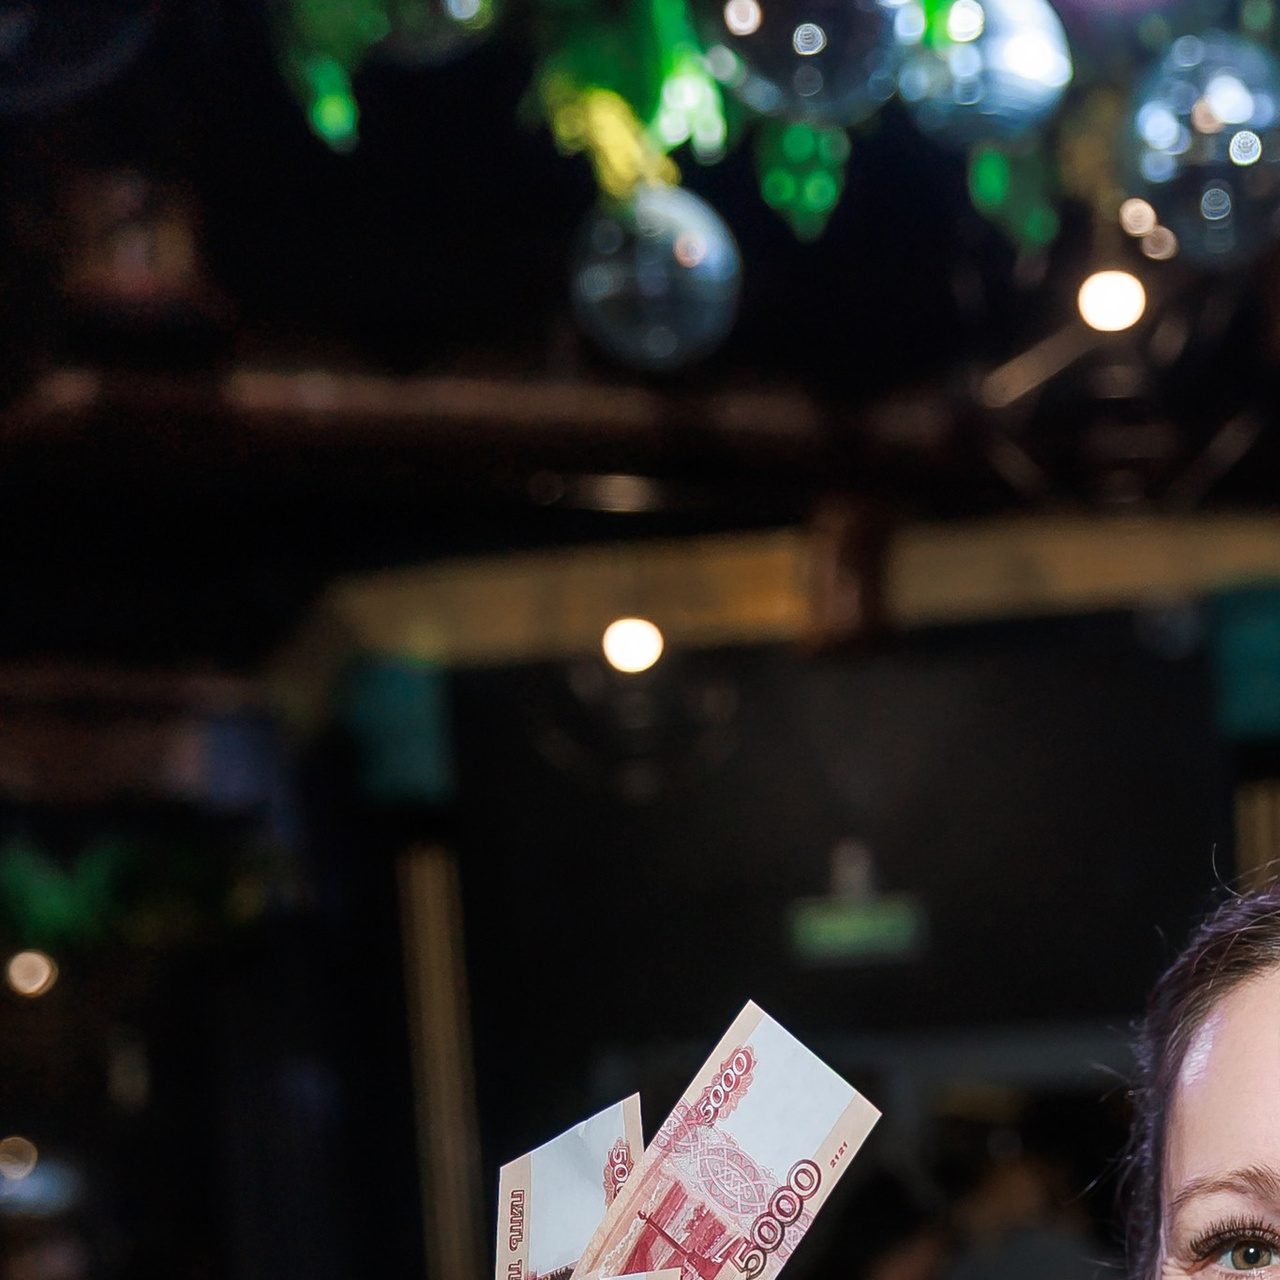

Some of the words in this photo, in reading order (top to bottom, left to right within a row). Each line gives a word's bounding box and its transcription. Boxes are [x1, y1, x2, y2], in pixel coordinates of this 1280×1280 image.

[699, 1052, 748, 1124] 5000
[611, 1147, 629, 1193] 50
[829, 1141, 850, 1169] 2121
[508, 1189, 525, 1251] ПЯТЬ
[729, 1158, 822, 1280] 5000
